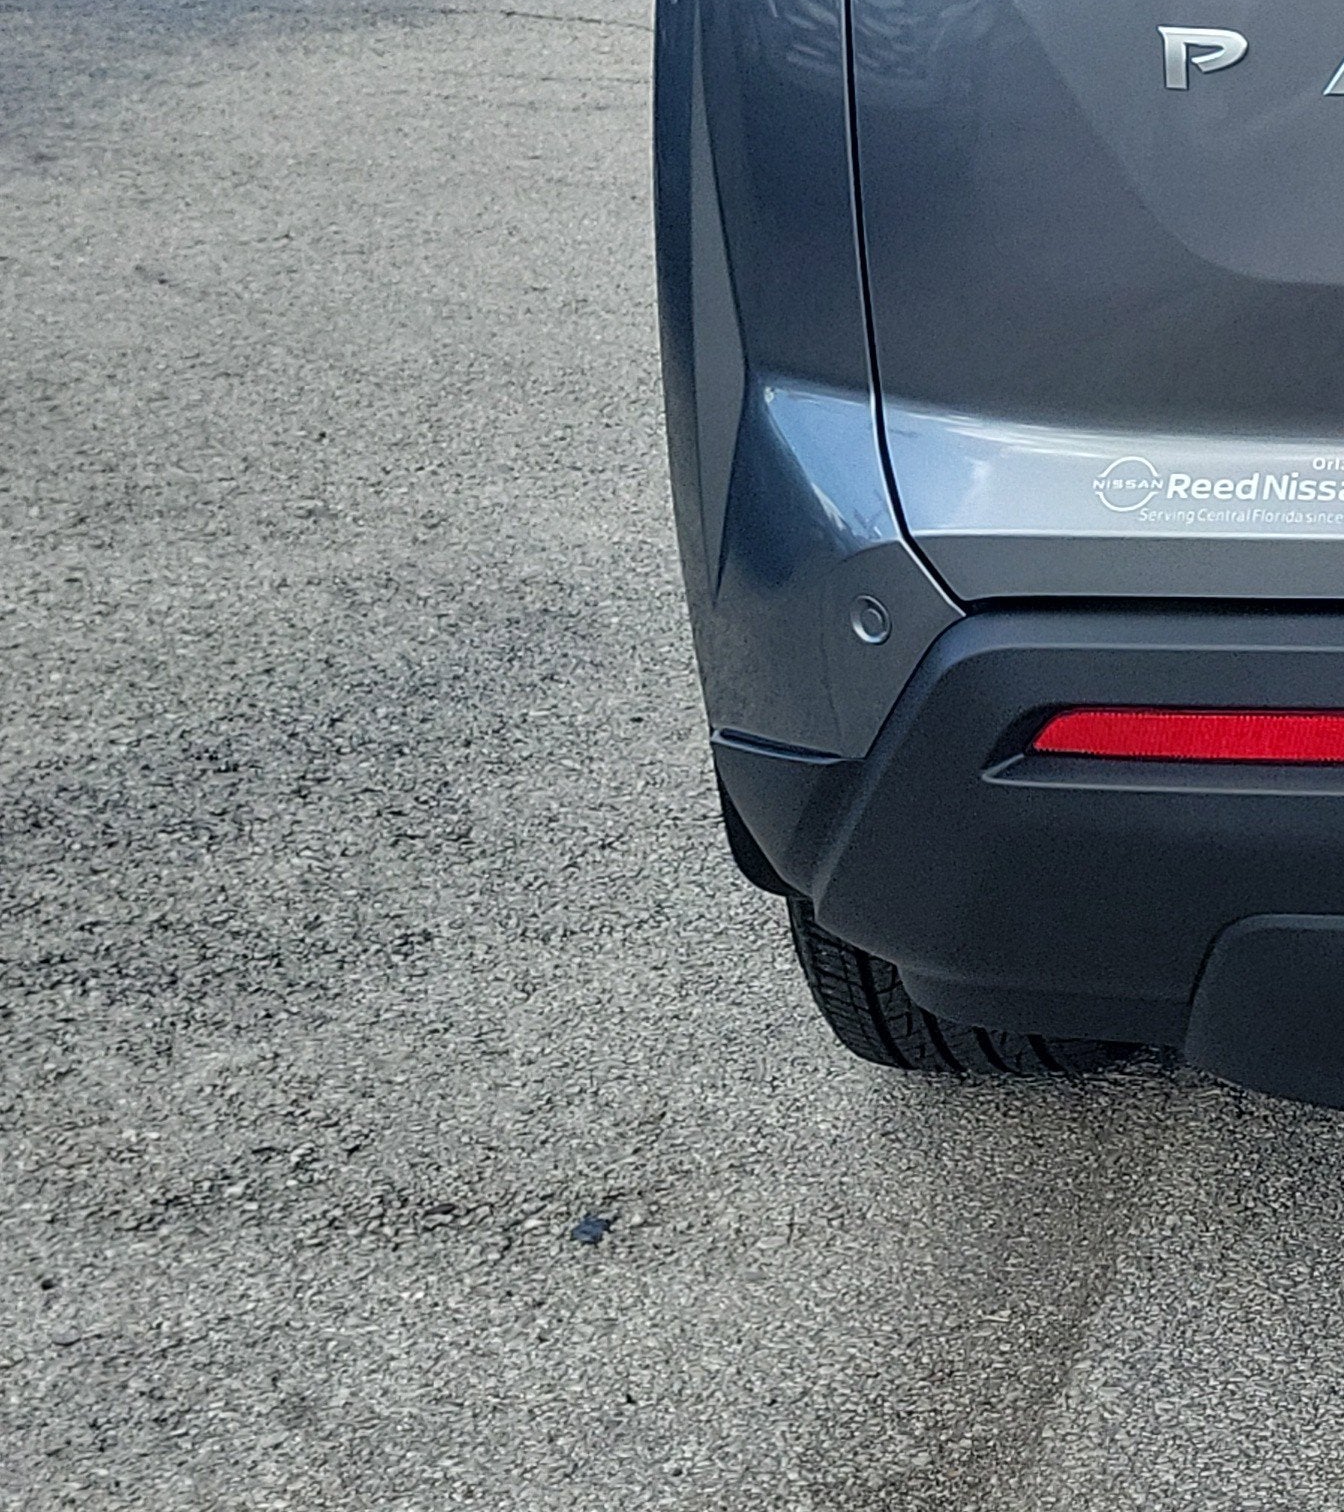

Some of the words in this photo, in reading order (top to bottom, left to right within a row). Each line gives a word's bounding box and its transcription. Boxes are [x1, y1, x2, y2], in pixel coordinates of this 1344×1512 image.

[1092, 479, 1163, 489] NISSAN
[1139, 508, 1195, 524] Serving
[1197, 508, 1250, 522] Central
[1252, 509, 1303, 523] Florida
[1306, 512, 1344, 524] since
